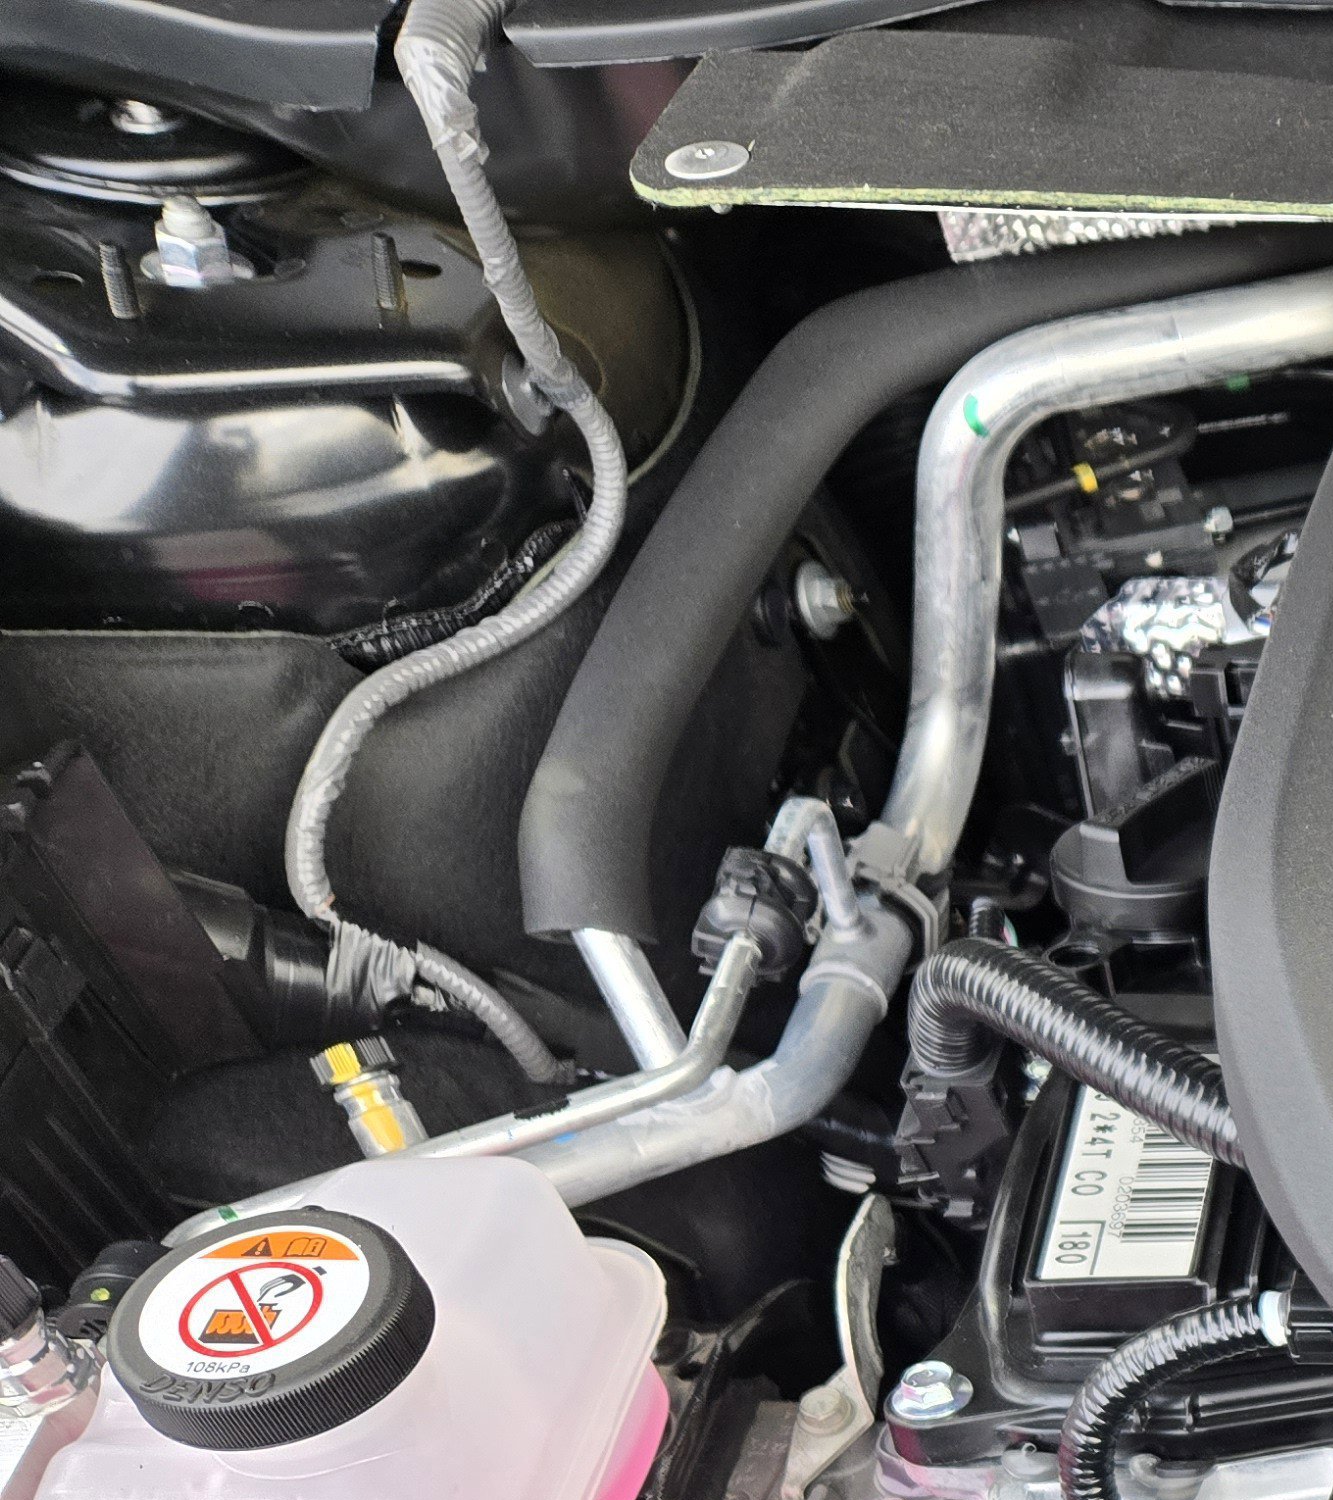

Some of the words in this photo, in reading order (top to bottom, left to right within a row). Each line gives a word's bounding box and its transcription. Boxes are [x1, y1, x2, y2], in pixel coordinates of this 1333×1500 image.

[1108, 1176, 1135, 1239] 0203697
[1055, 1231, 1092, 1265] 180
[186, 1361, 251, 1374] 108kPa
[139, 1373, 276, 1404] DENSO
